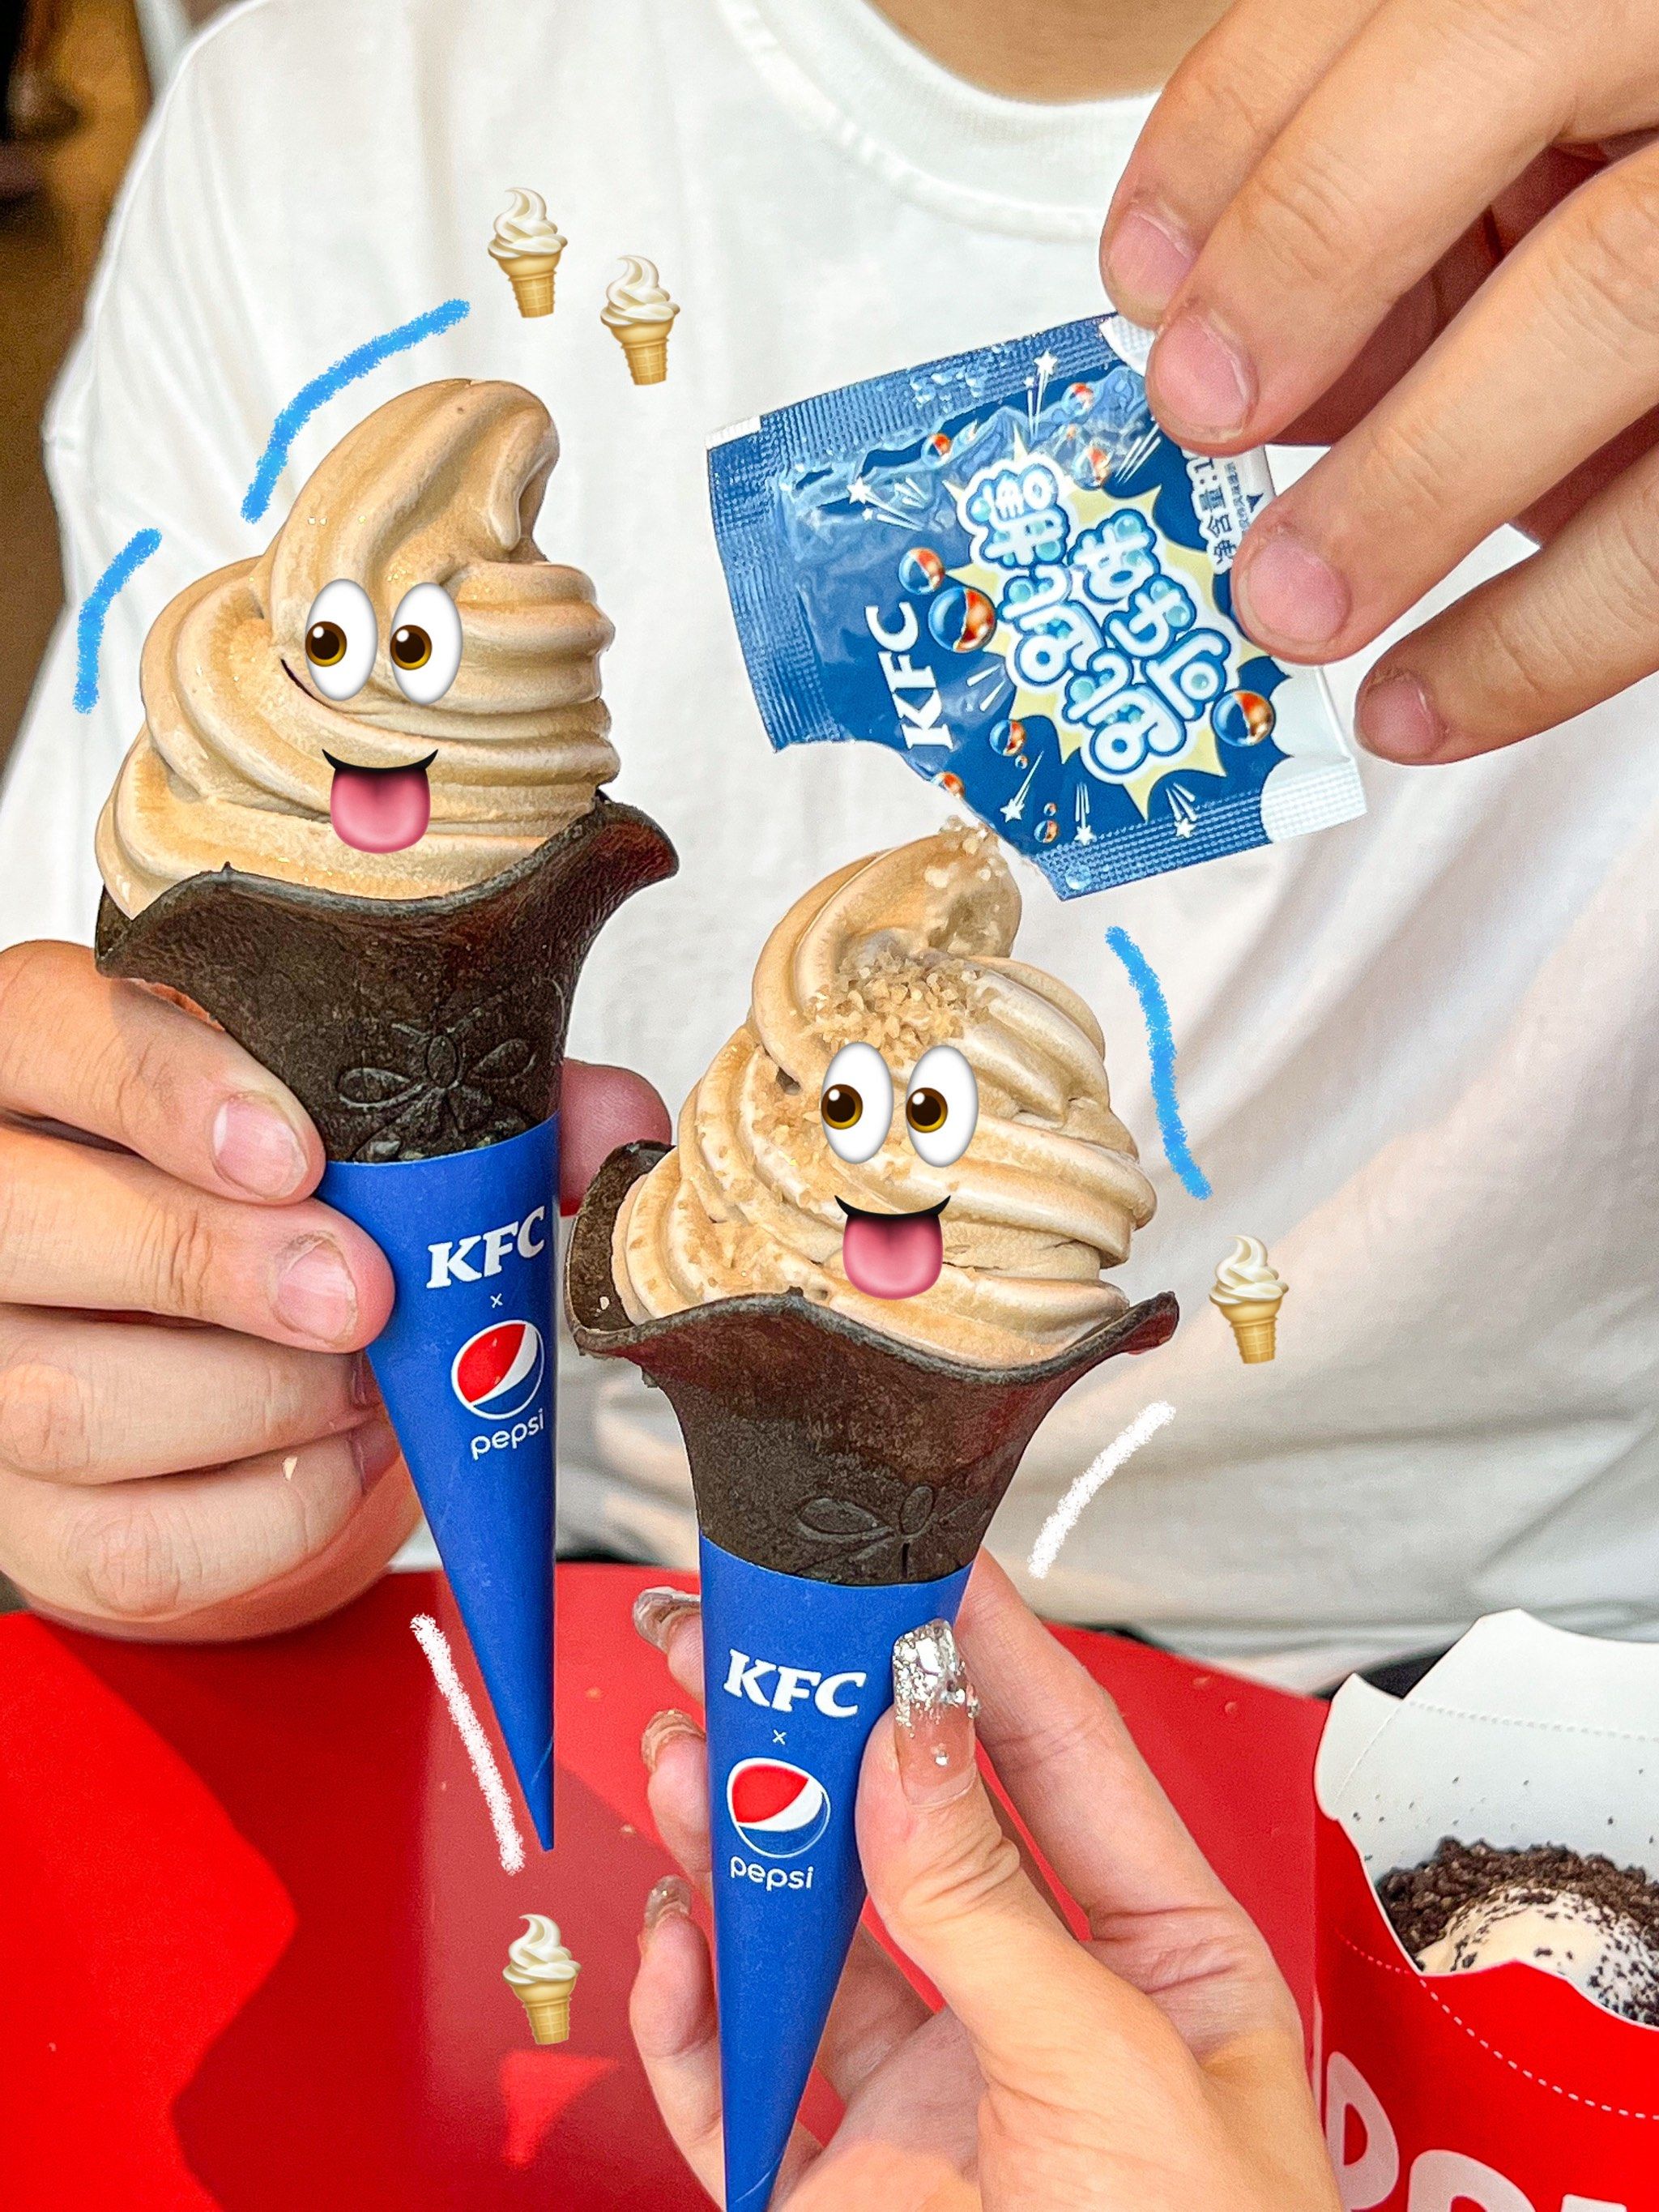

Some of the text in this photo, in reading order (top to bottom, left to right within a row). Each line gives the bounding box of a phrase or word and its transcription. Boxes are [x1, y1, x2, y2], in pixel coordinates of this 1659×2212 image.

[971, 465, 1185, 773] 跳跳糖
[1071, 512, 1230, 720] 可乐味
[866, 601, 953, 750] KFC
[426, 1206, 546, 1289] KFC
[471, 1408, 545, 1461] pepsi
[723, 1648, 867, 1718] KFC
[730, 1855, 814, 1891] pepsi
